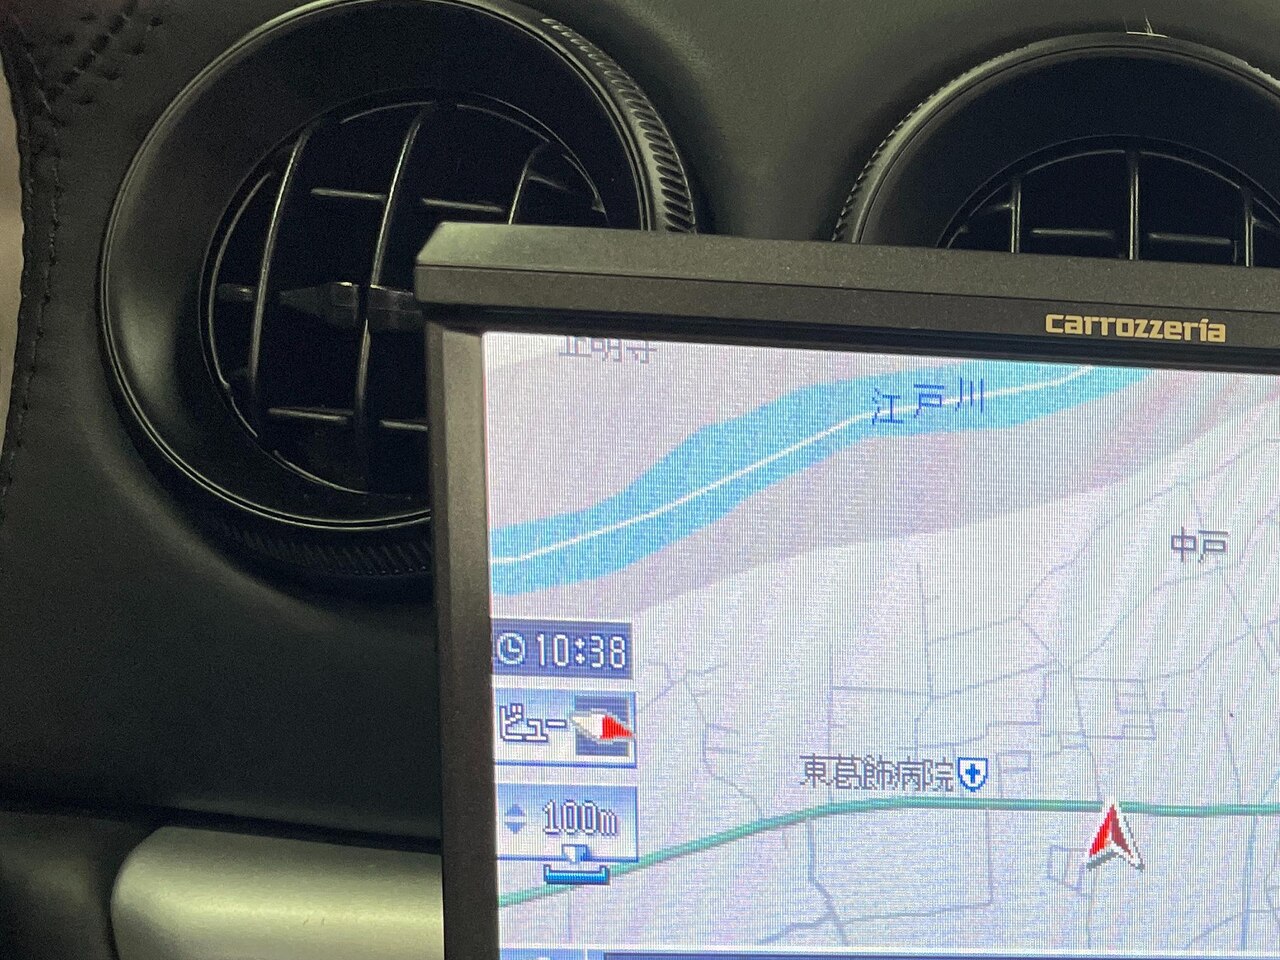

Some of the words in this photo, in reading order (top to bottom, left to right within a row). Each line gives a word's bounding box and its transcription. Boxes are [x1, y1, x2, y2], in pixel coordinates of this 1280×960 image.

[1045, 314, 1227, 343] carrozzeria
[871, 377, 983, 425] 江戸川
[1170, 526, 1229, 563] 中戸
[537, 633, 626, 668] 10:38
[499, 702, 567, 742] ビュー
[799, 753, 955, 792] 東葛飾病院
[543, 799, 617, 836] 100m
